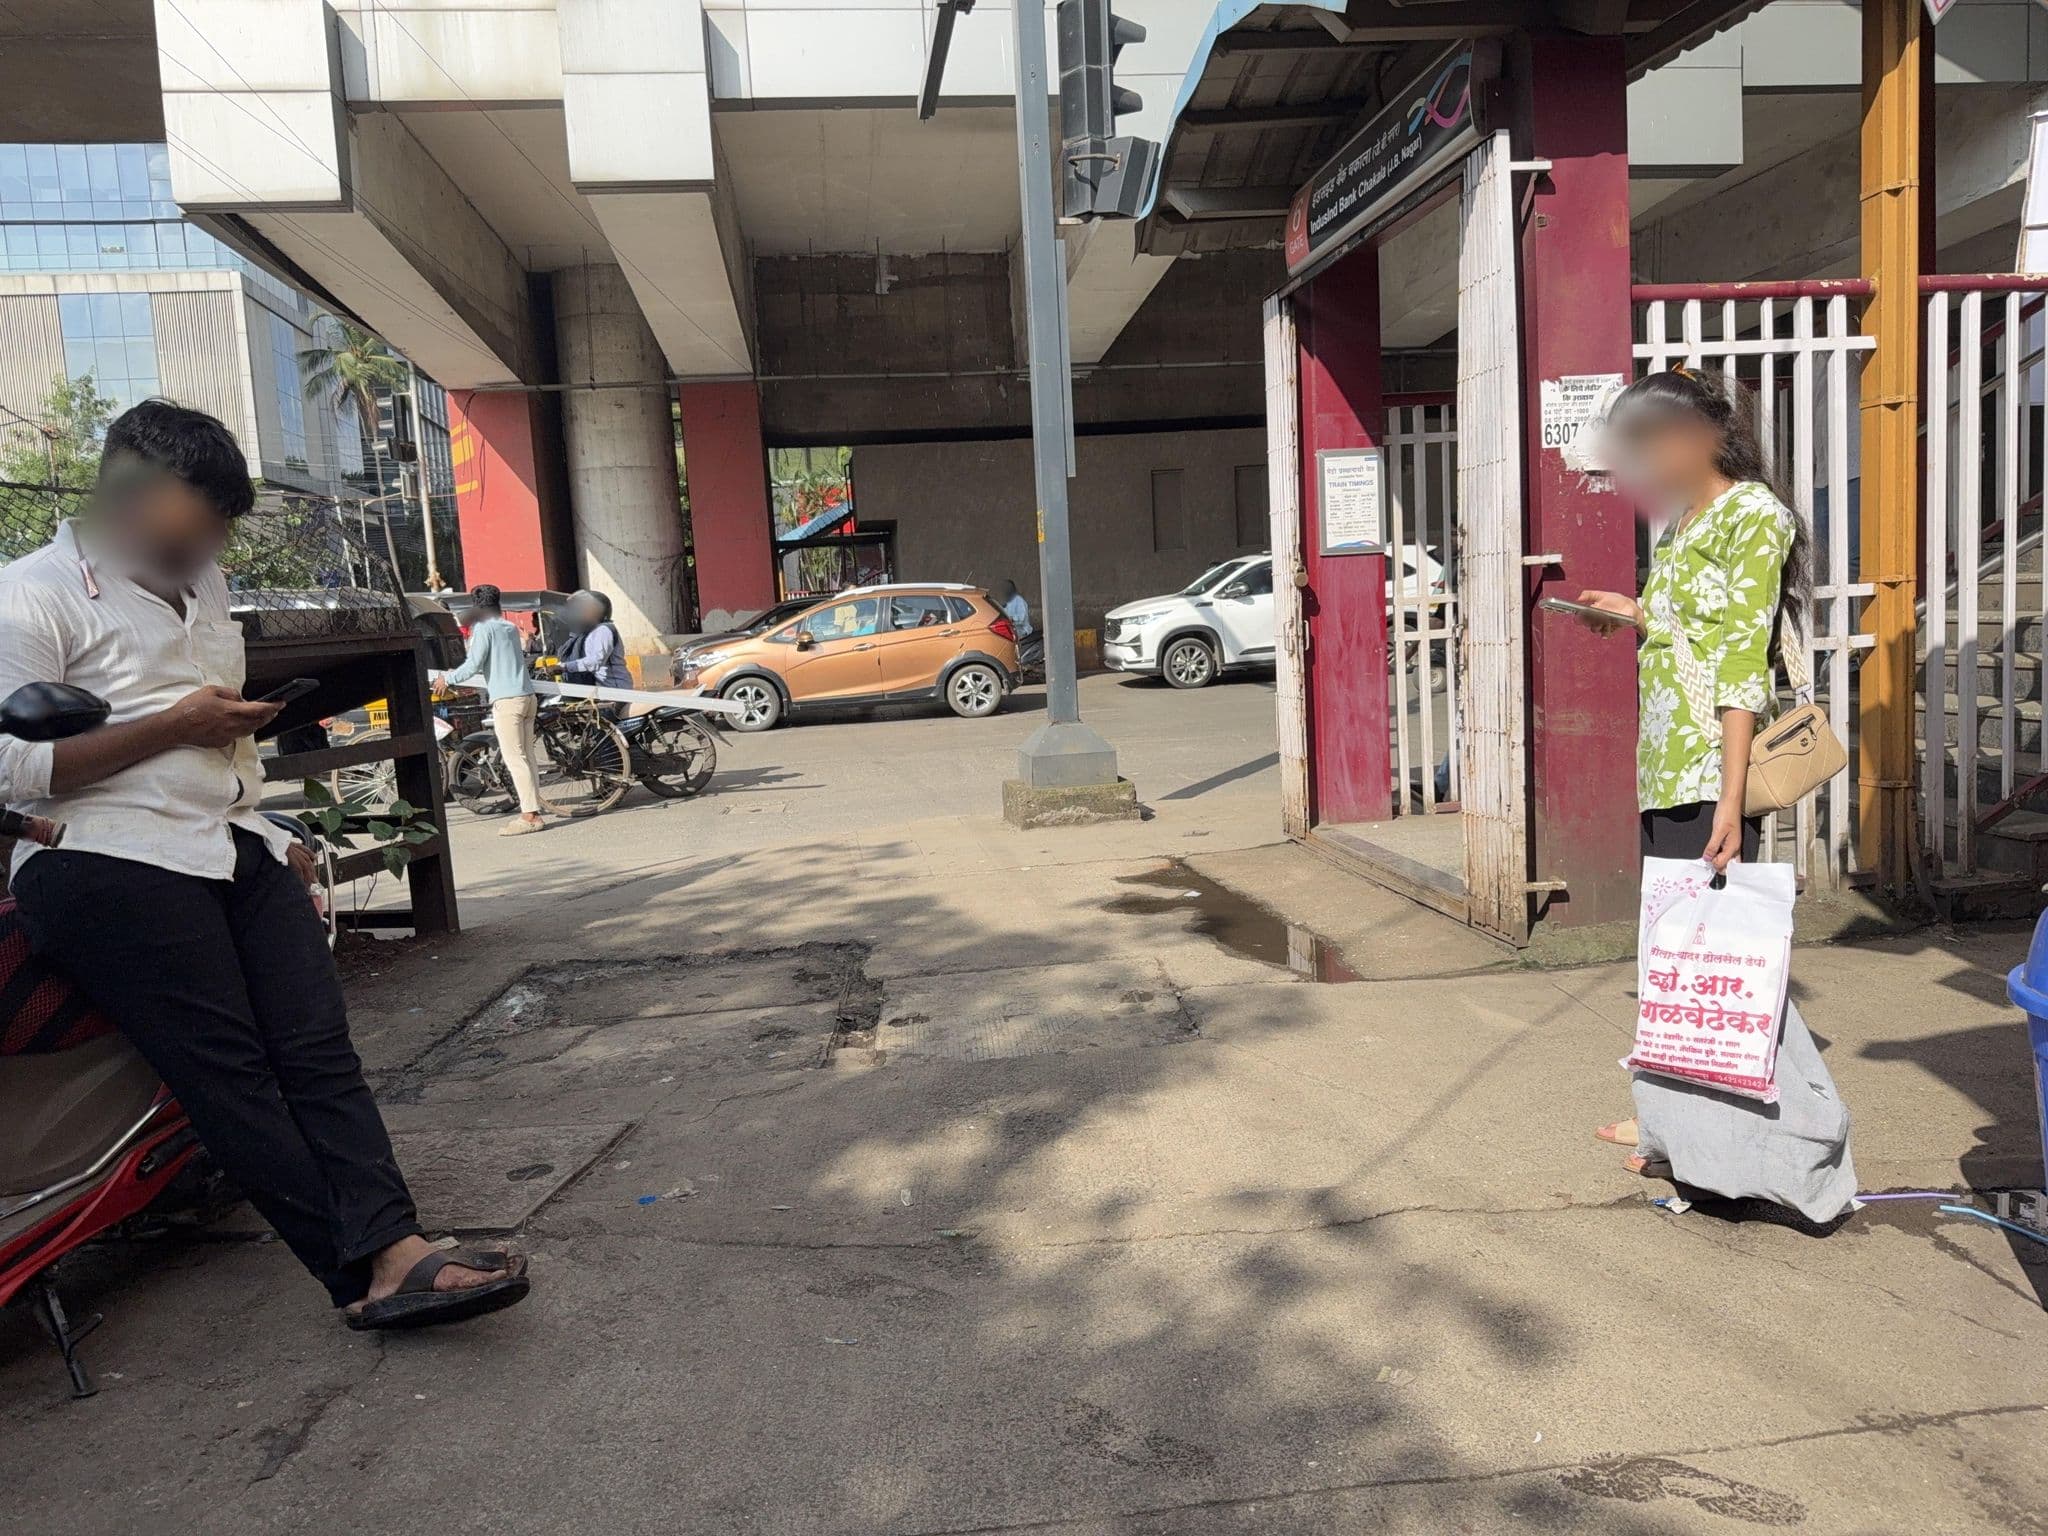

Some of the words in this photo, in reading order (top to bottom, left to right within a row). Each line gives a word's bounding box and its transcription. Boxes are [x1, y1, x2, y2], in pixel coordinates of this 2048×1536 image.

[1310, 201, 1338, 235] IndusInd
[1339, 188, 1357, 213] Bank
[1358, 165, 1386, 198] Chakala
[1401, 132, 1422, 162] Nagar)
[1289, 237, 1305, 255] GATE
[1544, 422, 1586, 446] 6307
[1349, 479, 1374, 487] TIMINGS
[1702, 951, 1742, 966] होलसेल
